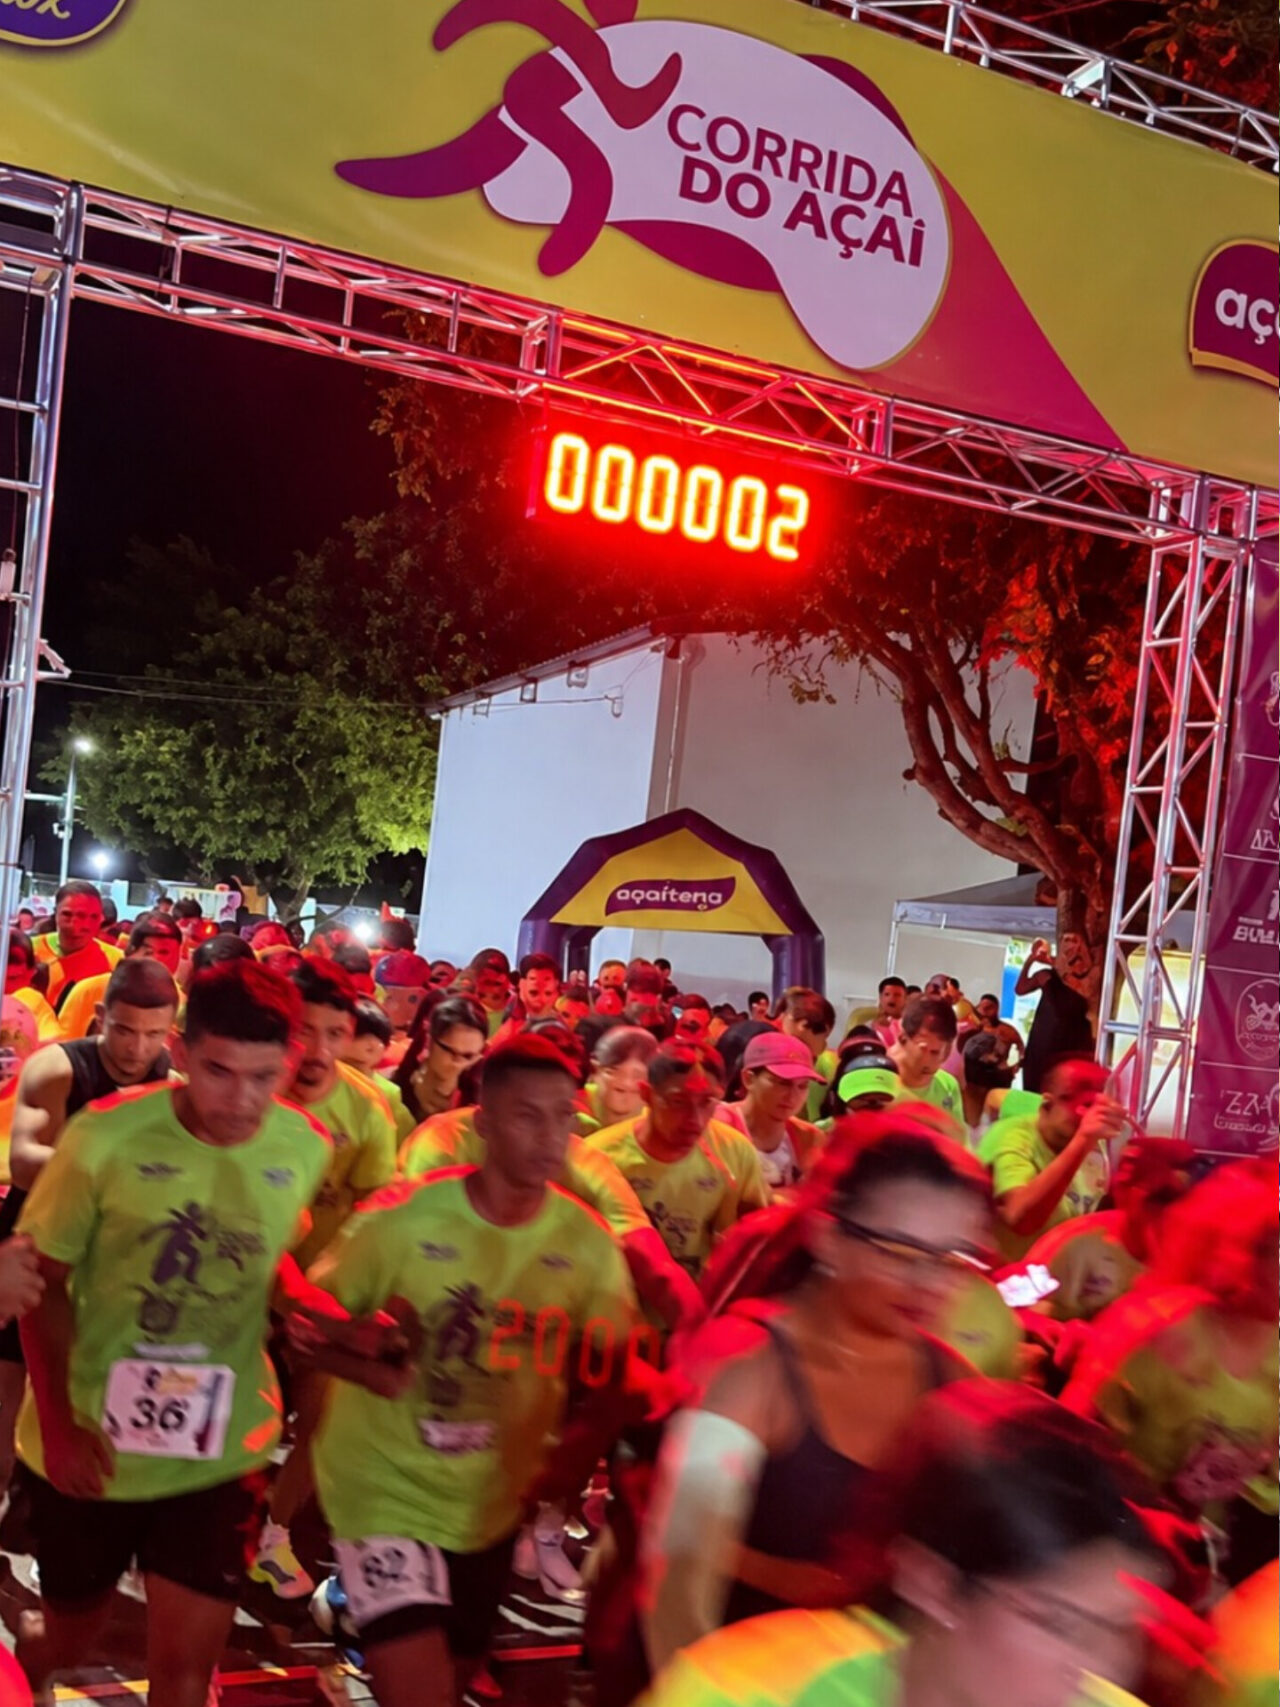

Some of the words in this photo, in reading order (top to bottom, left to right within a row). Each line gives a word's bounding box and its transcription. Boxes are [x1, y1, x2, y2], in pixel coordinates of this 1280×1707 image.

[667, 104, 913, 218] CORRIDA
[679, 155, 772, 219] DO
[782, 190, 926, 267] AÇAÍ
[1215, 288, 1279, 345] aç
[545, 432, 810, 562] 000002
